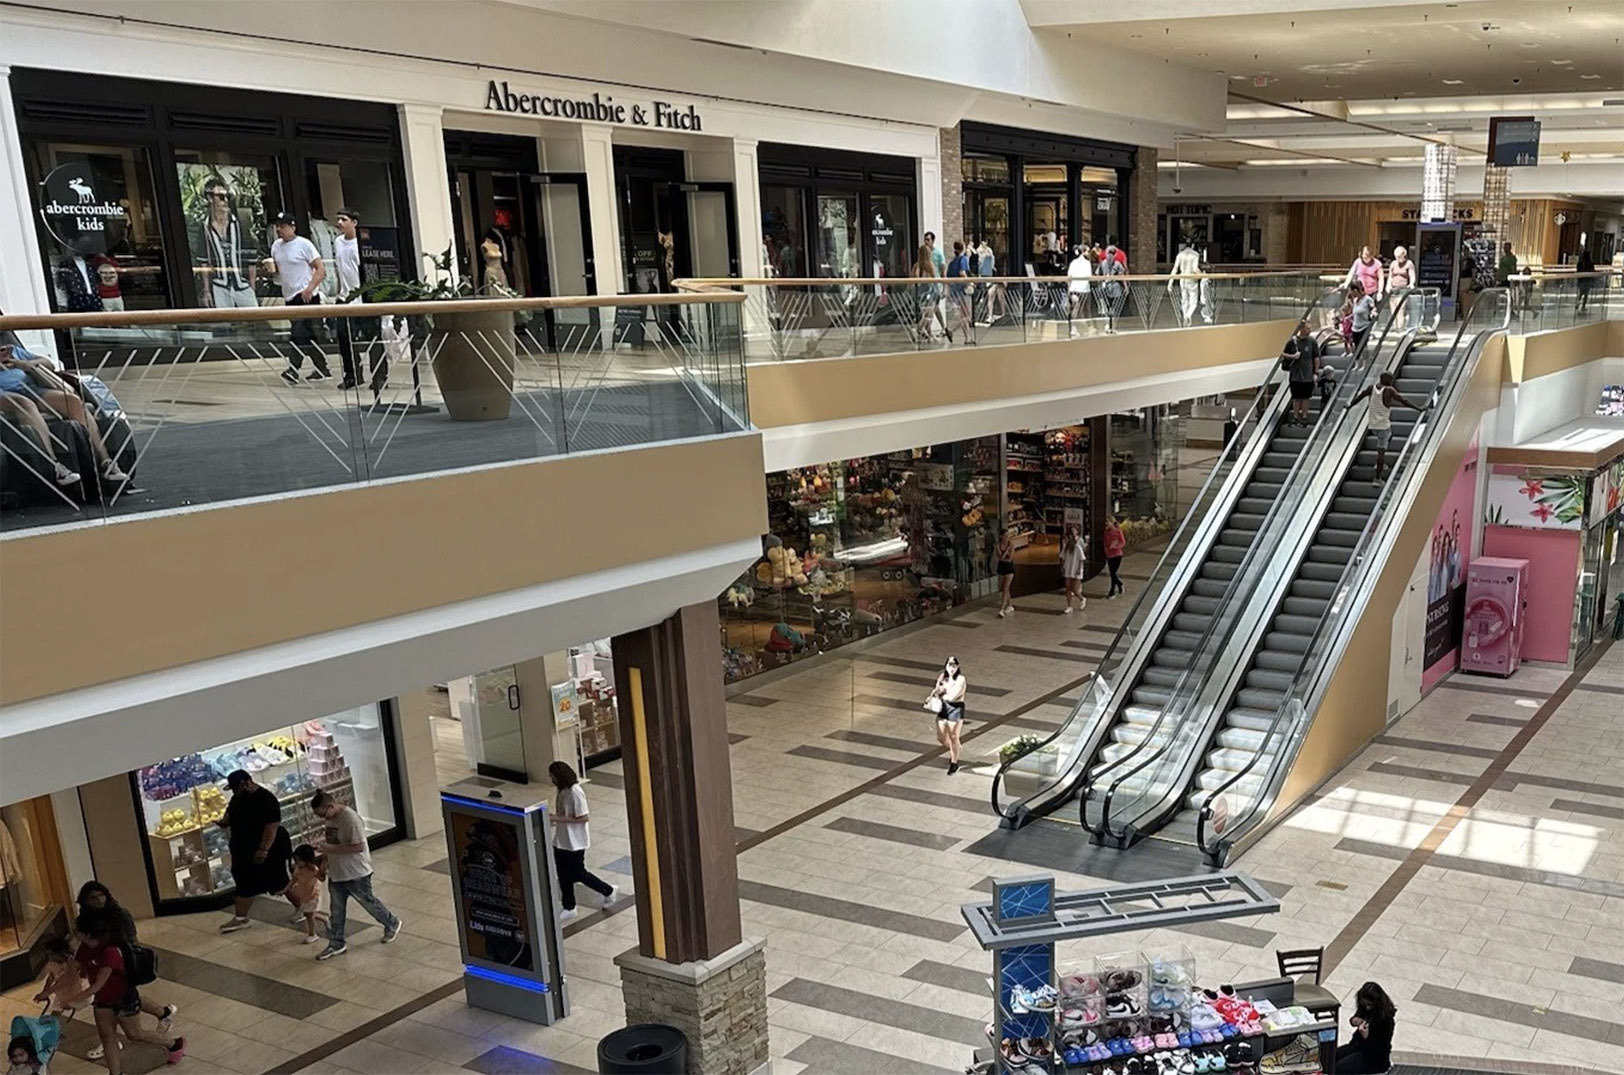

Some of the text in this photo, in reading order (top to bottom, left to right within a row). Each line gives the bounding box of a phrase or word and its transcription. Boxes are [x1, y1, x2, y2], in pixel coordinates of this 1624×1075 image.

[484, 79, 703, 131] Abercrombie & Fitch
[46, 200, 125, 215] abercrombie
[1402, 208, 1474, 219] STACKS
[76, 216, 105, 231] kids
